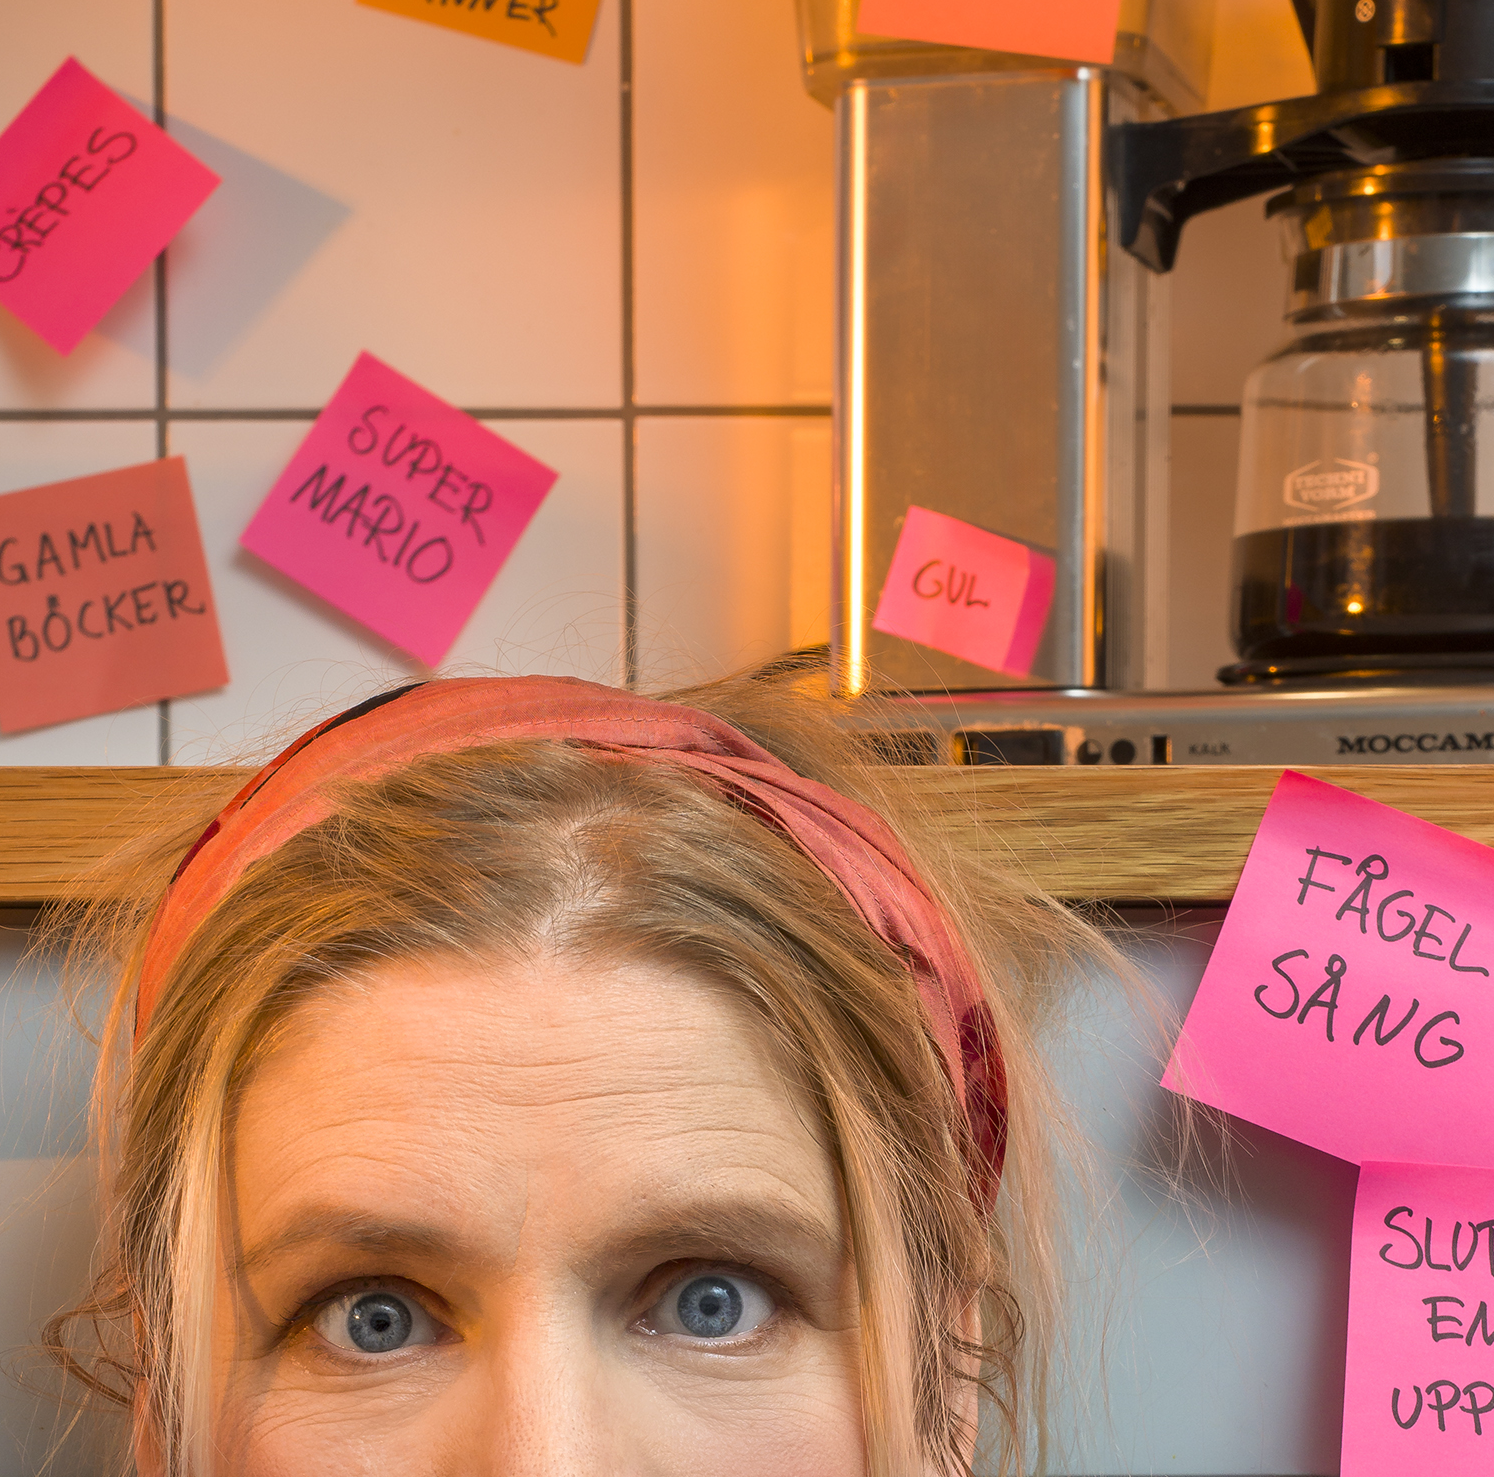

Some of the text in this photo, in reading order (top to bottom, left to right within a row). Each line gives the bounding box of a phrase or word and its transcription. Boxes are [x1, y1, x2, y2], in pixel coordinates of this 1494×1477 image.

[290, 464, 453, 583] MARIO
[348, 405, 493, 545] SUPER
[6, 580, 206, 662] BÖCKER
[913, 561, 988, 607] GUL
[1254, 949, 1464, 1068] SÅNG
